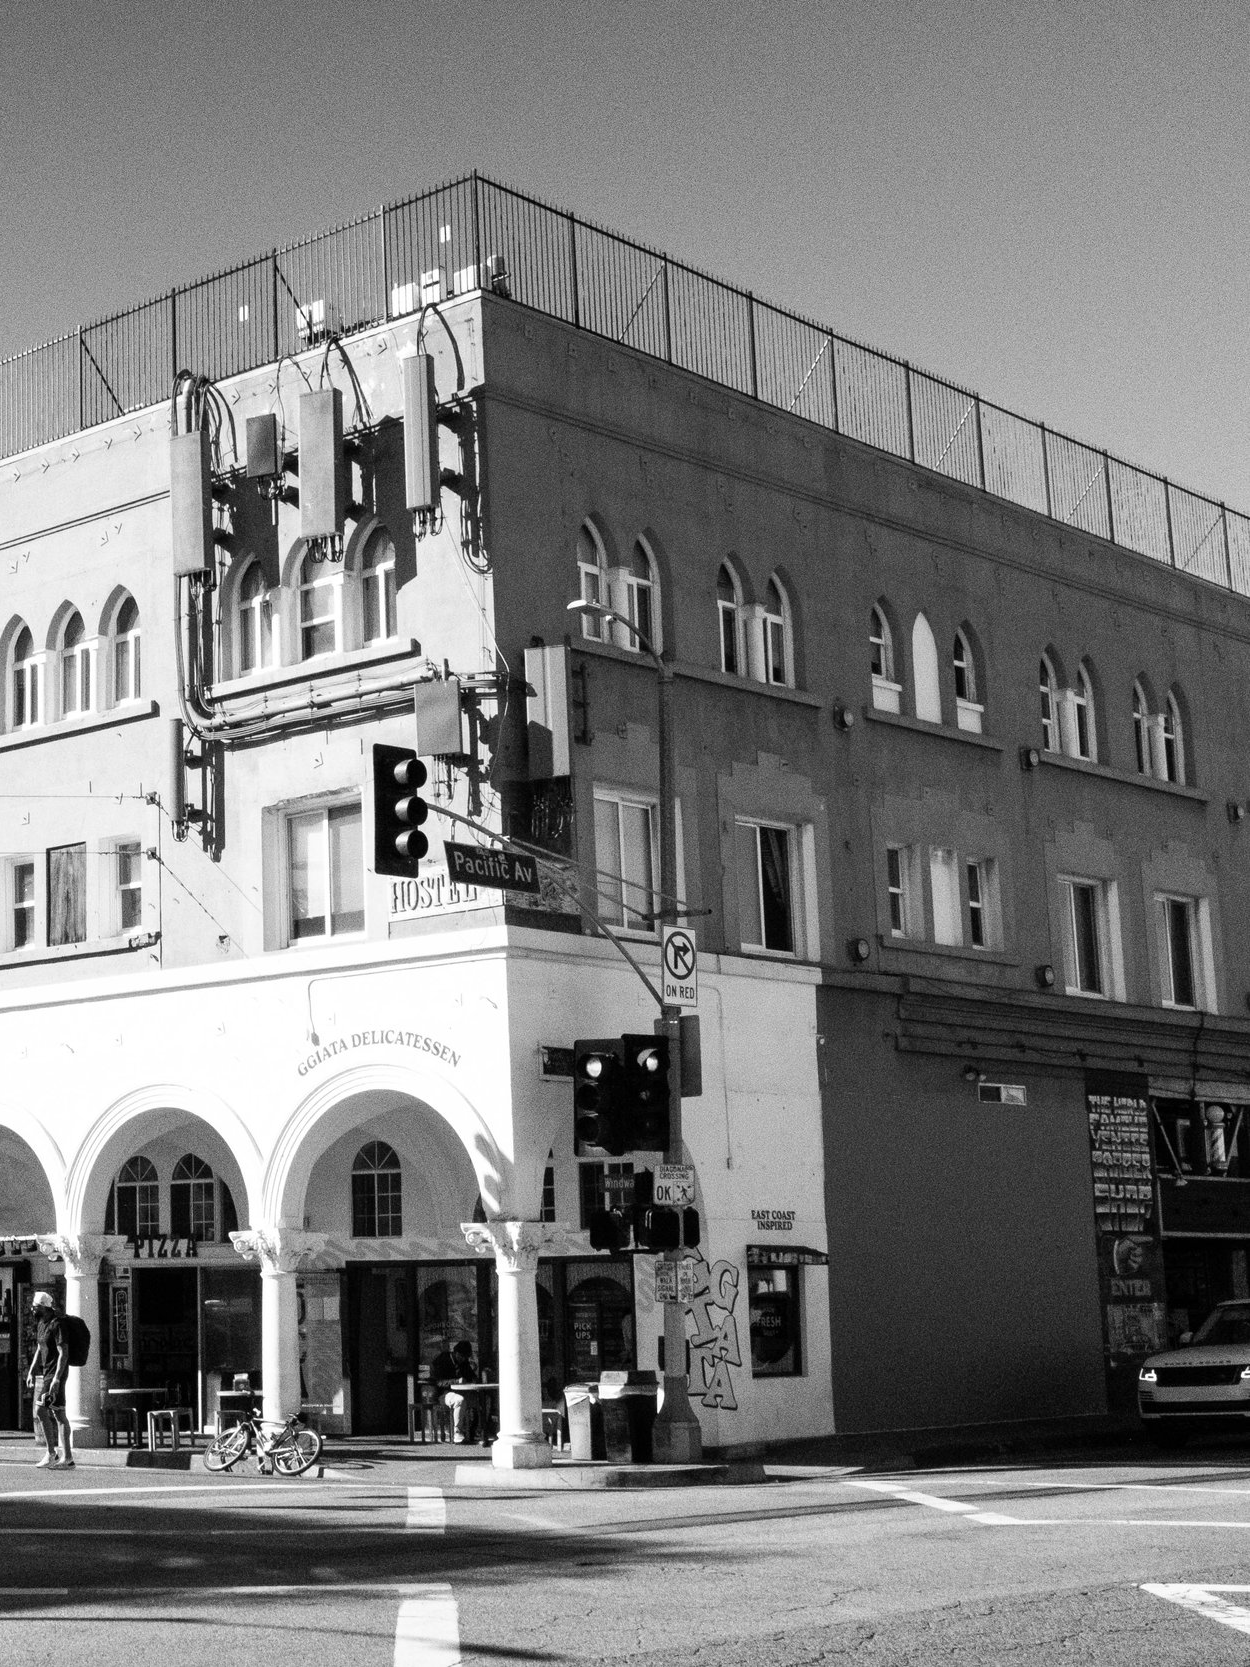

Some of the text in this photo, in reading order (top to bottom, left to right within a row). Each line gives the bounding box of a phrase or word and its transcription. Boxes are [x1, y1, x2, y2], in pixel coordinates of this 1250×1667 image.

[453, 851, 532, 883] Pacific Av
[391, 874, 478, 914] HOSTEL
[666, 984, 695, 999] ON RED
[297, 1030, 462, 1077] GGIATA DELICATESSEN
[604, 1177, 635, 1189] Windwa
[656, 1185, 671, 1201] OK
[751, 1210, 796, 1220] EAST COAST
[757, 1221, 793, 1231] INSPIRED
[134, 1233, 198, 1258] PIZZA
[1111, 1278, 1152, 1296] ENTER
[574, 1322, 592, 1331] PICK
[575, 1331, 591, 1340] UPS
